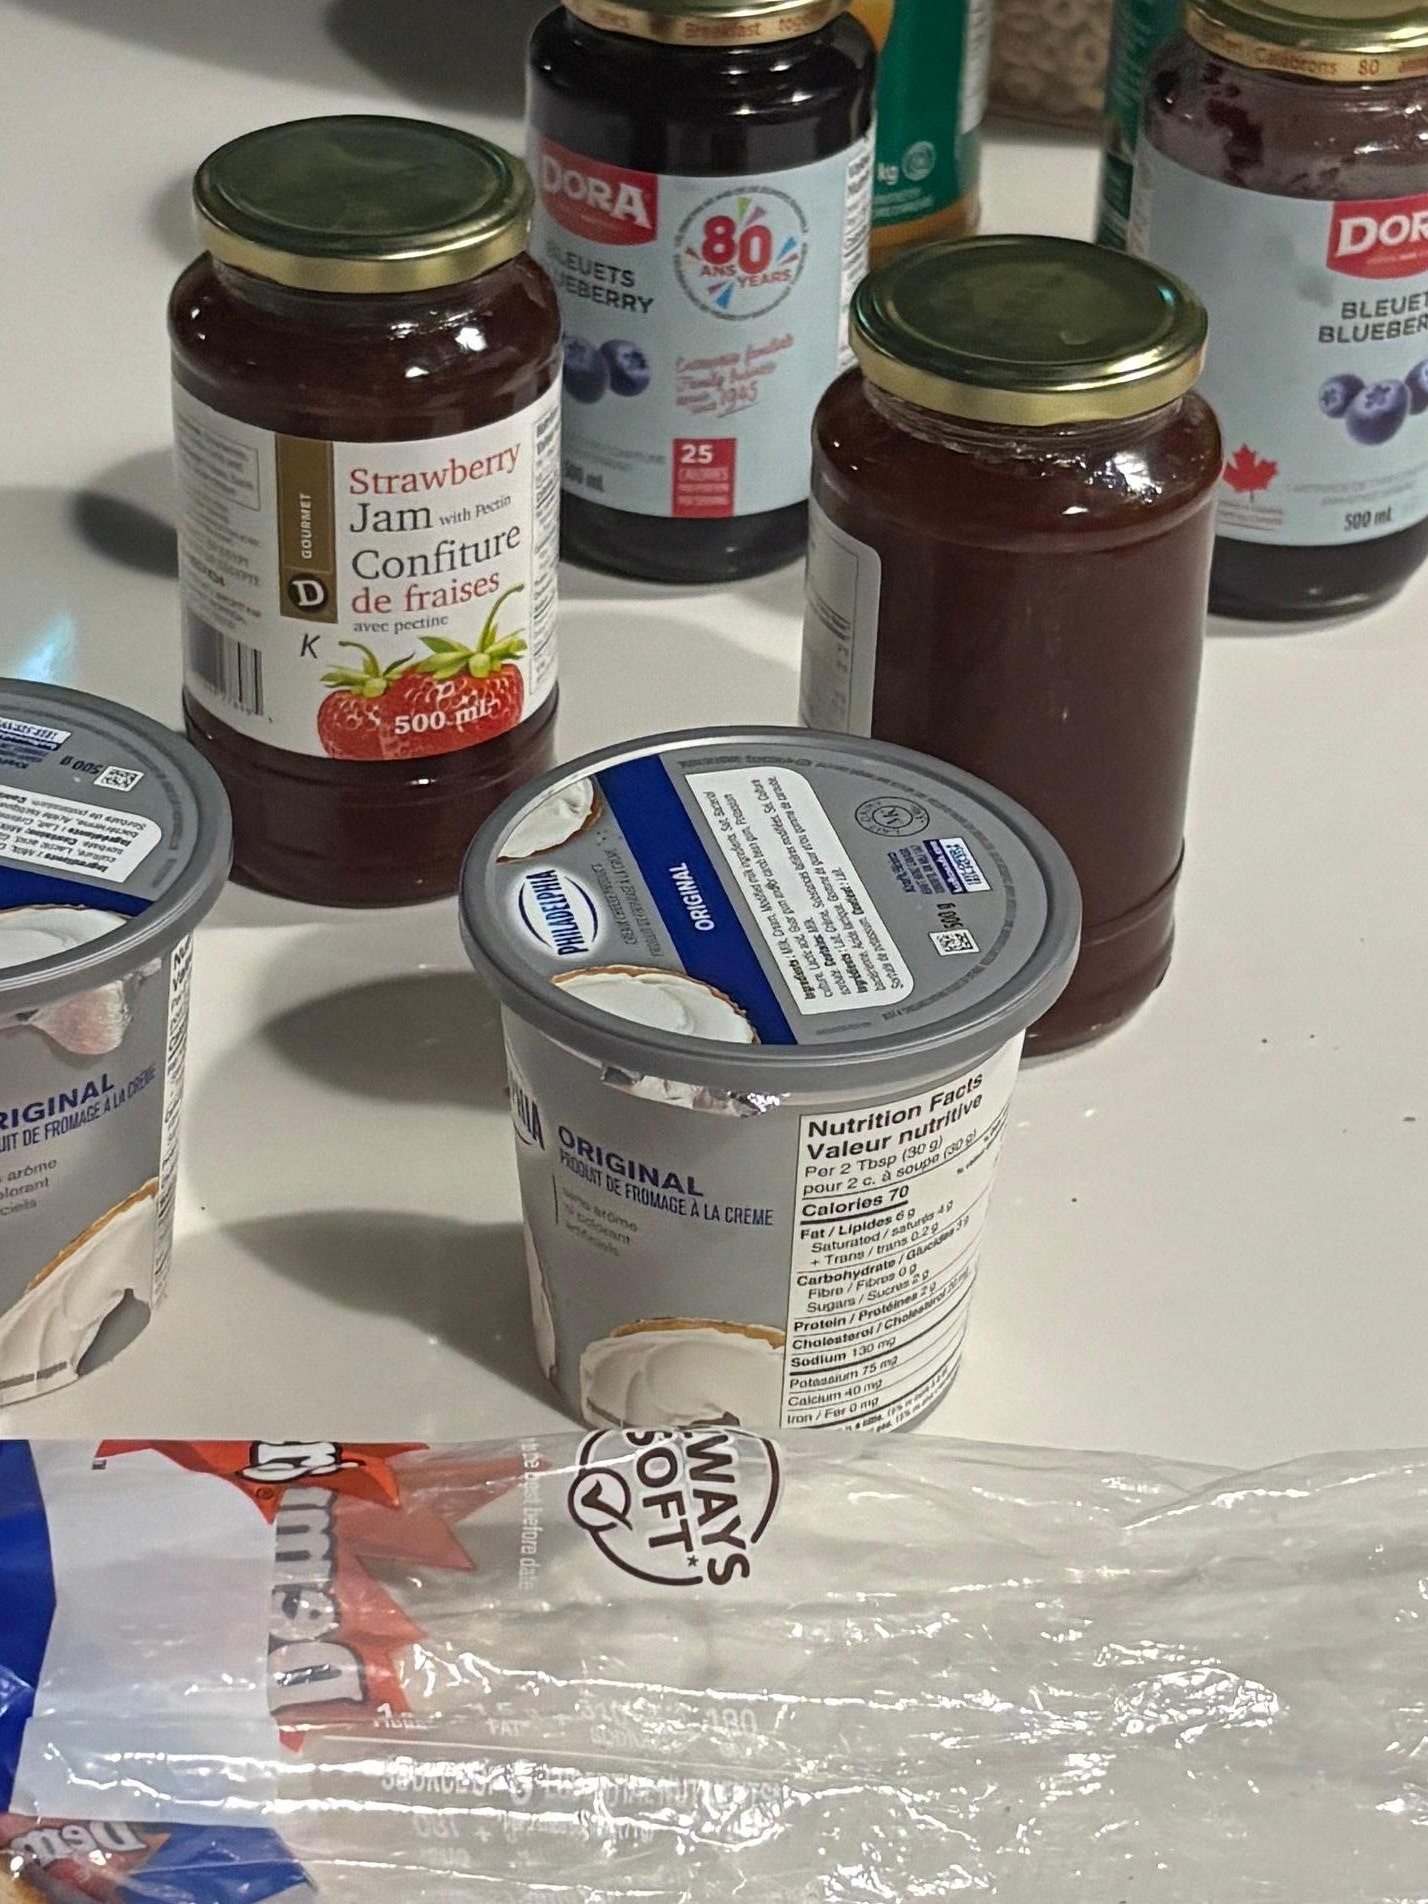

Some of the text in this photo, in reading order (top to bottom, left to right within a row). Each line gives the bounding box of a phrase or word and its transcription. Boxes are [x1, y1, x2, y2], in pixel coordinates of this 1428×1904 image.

[541, 153, 653, 230] DORA
[702, 215, 771, 274] 80
[700, 264, 736, 278] ANS
[736, 270, 793, 288] YEARS
[681, 445, 714, 463] 25
[349, 443, 521, 495] Strawberry
[300, 493, 312, 560] GOURMET
[350, 495, 511, 533] Jam with Pectin
[1344, 510, 1371, 531] 500
[352, 525, 521, 580] Confiture
[351, 572, 500, 614] de fraises
[354, 614, 449, 634] avec pectine
[300, 633, 320, 659] K
[394, 711, 445, 734] 500
[71, 759, 102, 776] 500
[668, 862, 715, 931] ORIGINAL
[525, 869, 589, 956] PHILADELPHIA
[938, 911, 963, 929] 500
[809, 1073, 982, 1137] Nutrition Facts
[23, 1126, 40, 1146] DE
[45, 1104, 101, 1140] FROMAGE
[807, 1094, 982, 1159] Valeur nutritive
[7, 1159, 57, 1182] arôme
[559, 1126, 704, 1196] ORIGINAL
[803, 1154, 939, 1196] pour soupe
[805, 1146, 923, 1177] Per Tbsp (30
[559, 1148, 773, 1226] PRODUIT DE FROMAGE LA CRÈME
[802, 1185, 909, 1217] Calories 70
[800, 1216, 892, 1240] Fat Lipides
[811, 1213, 934, 1253] Saturated saturés
[824, 1238, 908, 1265] Trans trans
[797, 1258, 896, 1286] Carbohydrate
[808, 1273, 895, 1299] Fibre Fibres
[807, 1281, 910, 1313] Sugars Sucres
[794, 1317, 846, 1332] Protein
[792, 1329, 873, 1350] Cholesterol
[791, 1345, 874, 1367] Sodium 130
[790, 1371, 858, 1389] Potassium
[788, 1391, 842, 1406] Calcium
[787, 1407, 846, 1425] Iron Fer
